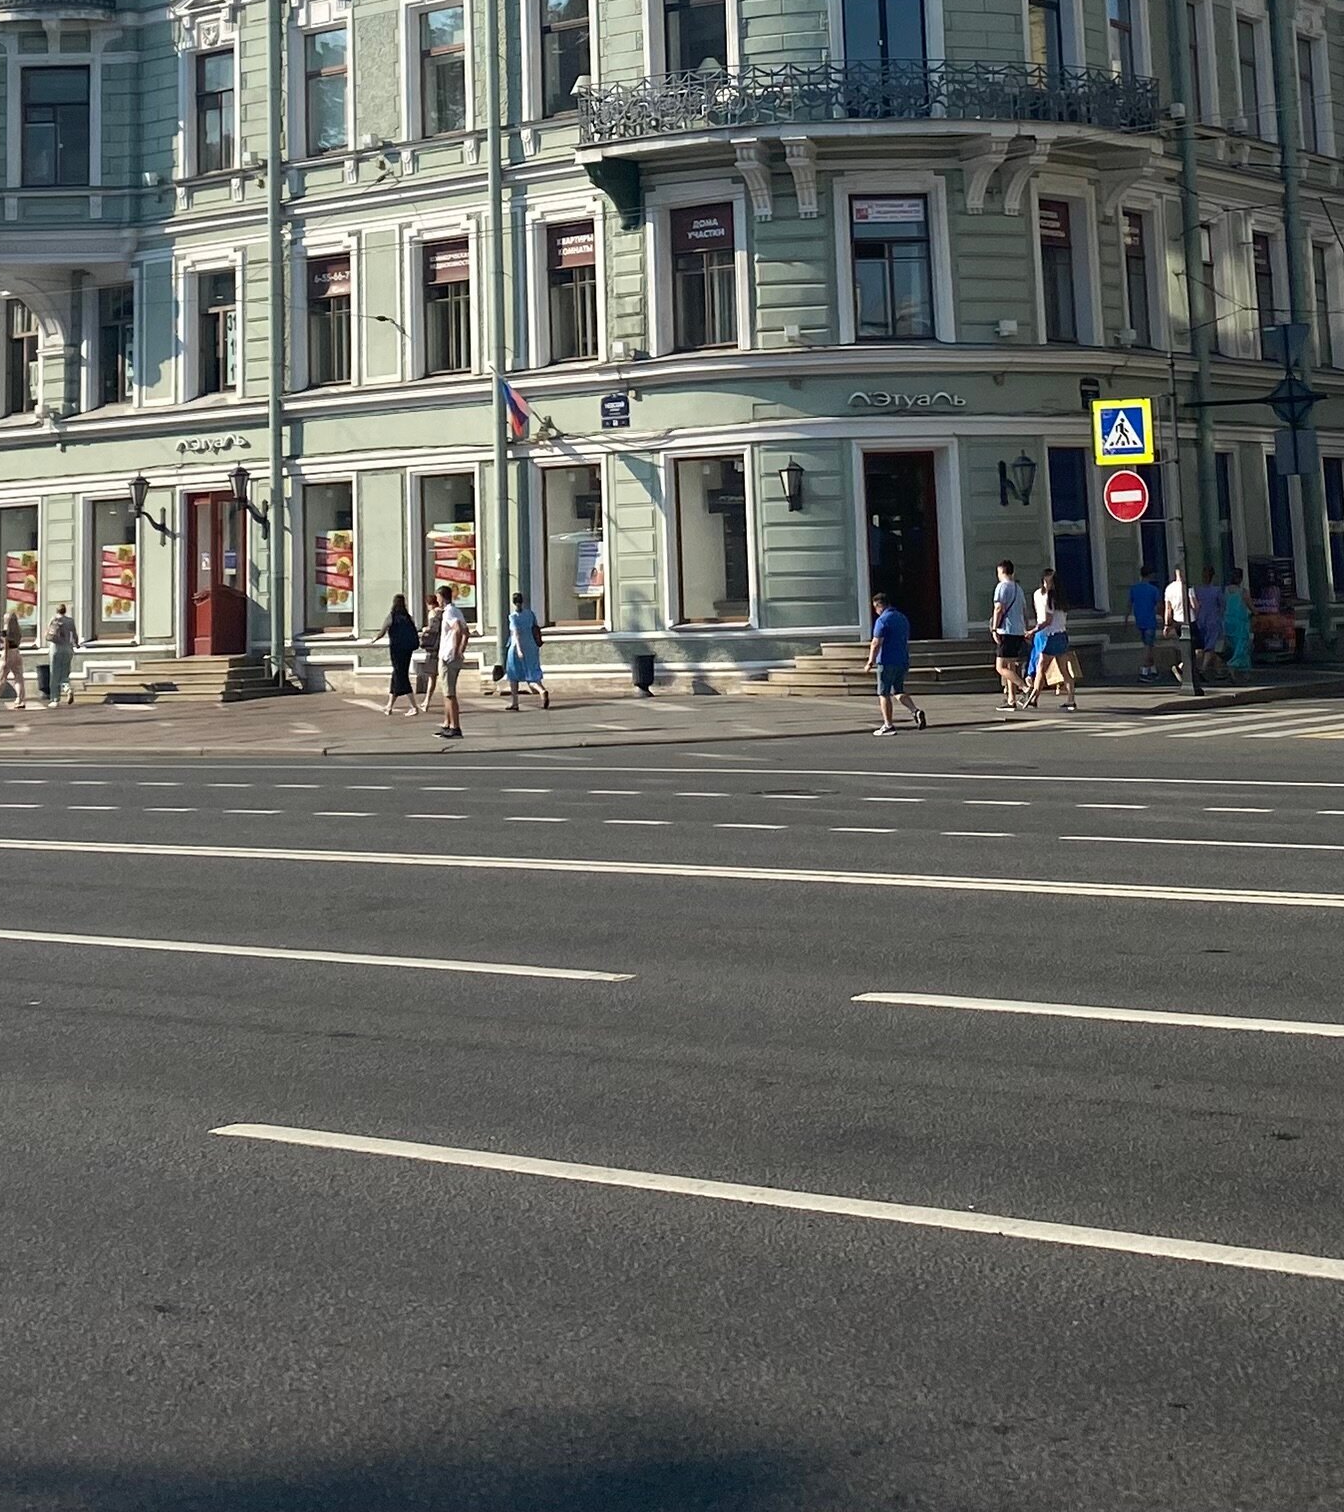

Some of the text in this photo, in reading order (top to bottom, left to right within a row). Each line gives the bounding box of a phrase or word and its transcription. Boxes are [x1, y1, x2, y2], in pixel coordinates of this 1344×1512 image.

[692, 218, 719, 230] ДОМА
[556, 233, 594, 246] КВАРТИРЫ
[687, 227, 725, 240] УЧАСТКИ
[557, 244, 593, 256] КОМНАТЫ
